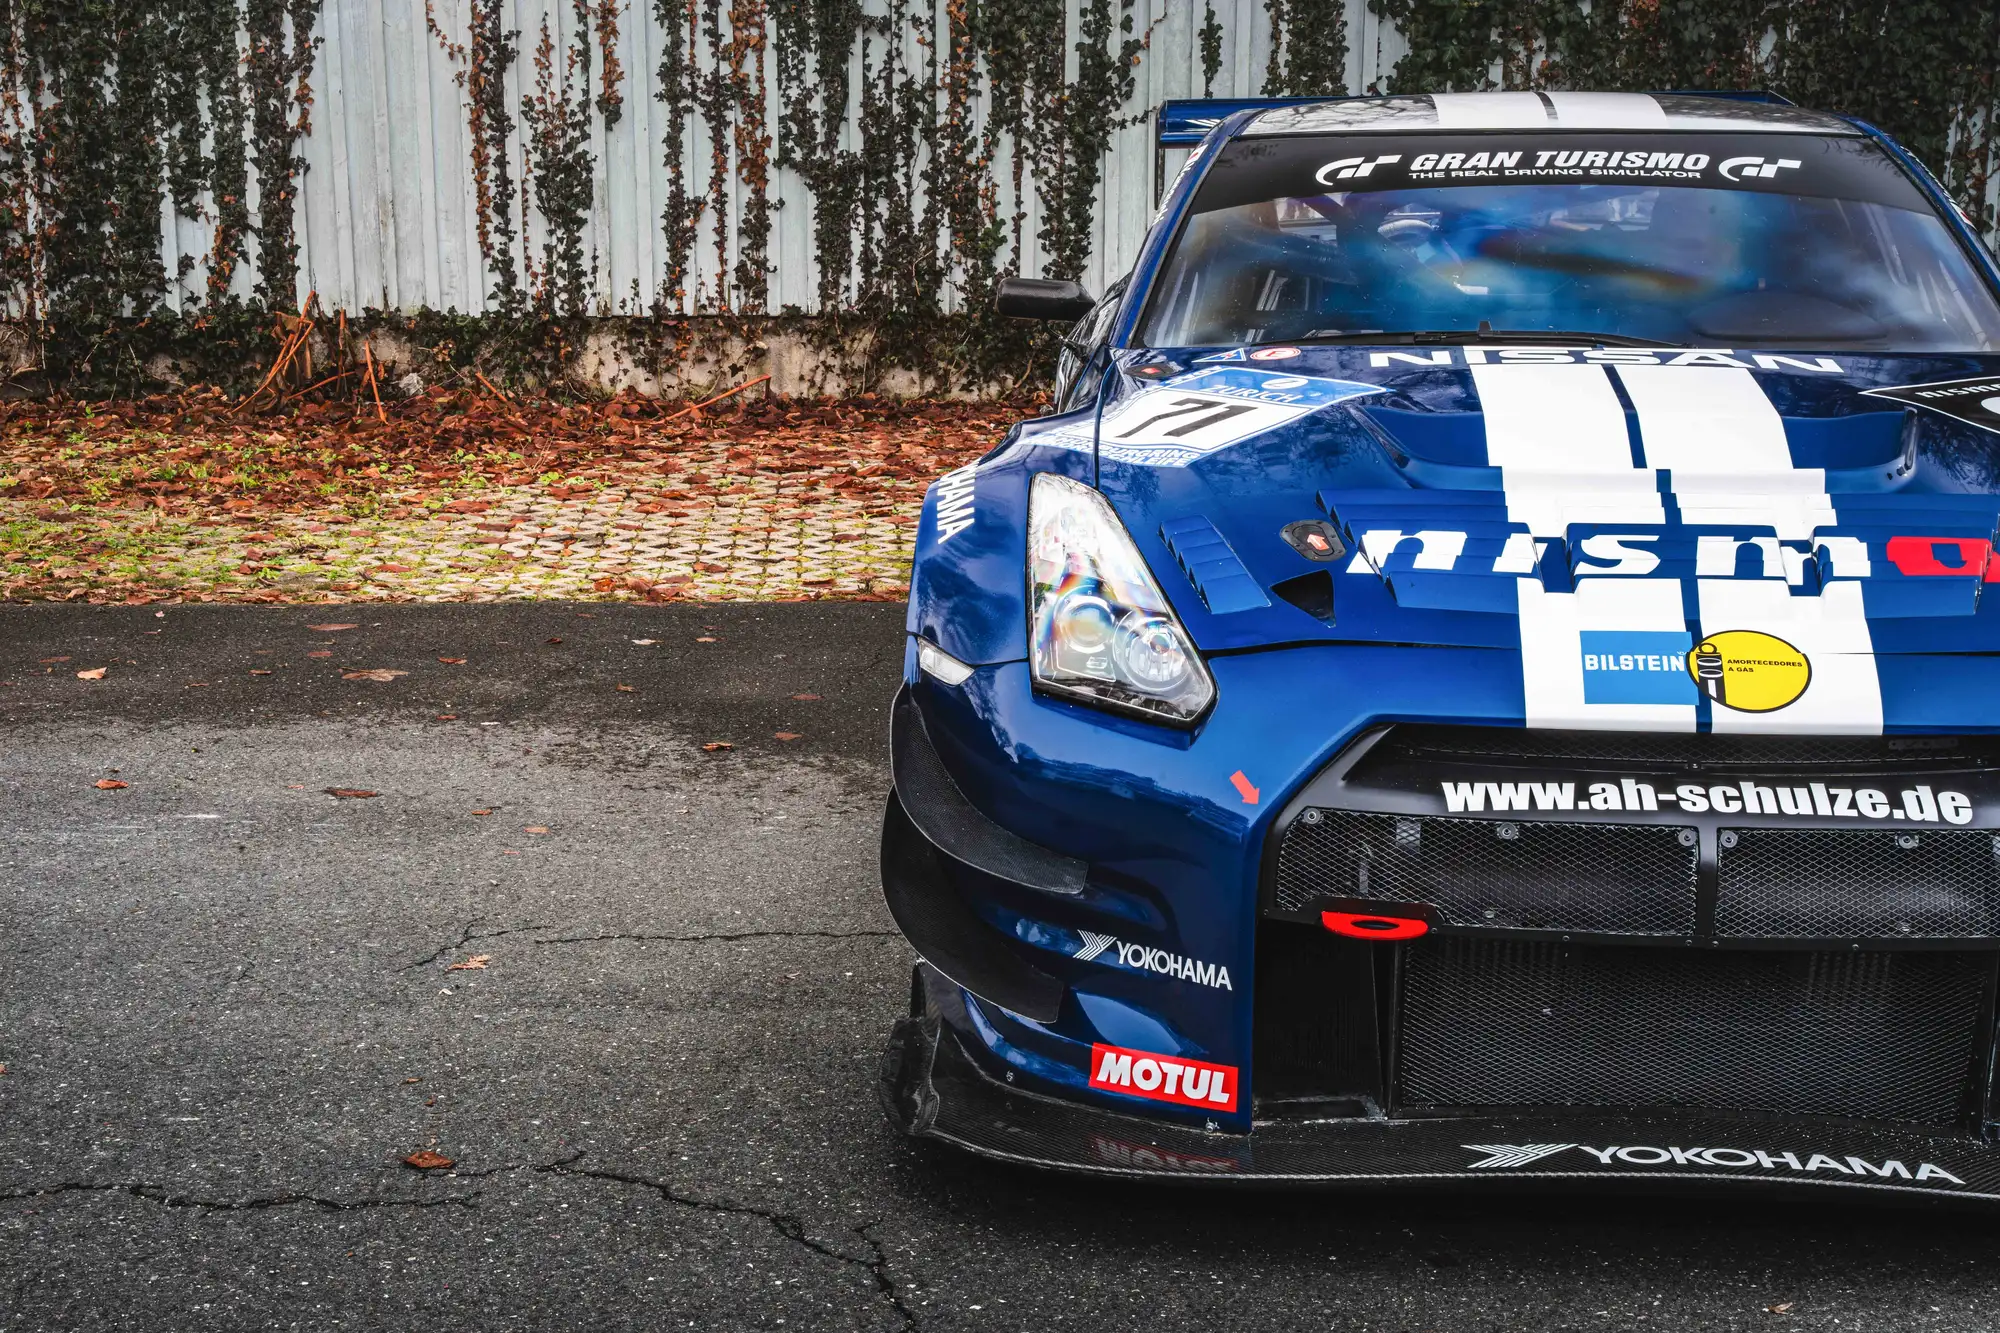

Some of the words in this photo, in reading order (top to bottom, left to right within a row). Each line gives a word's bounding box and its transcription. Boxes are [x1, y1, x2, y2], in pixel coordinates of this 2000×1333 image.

[1410, 151, 1523, 171] GRAN
[1534, 151, 1711, 171] TURISMO
[1451, 169, 1499, 177] REAL
[1505, 168, 1583, 176] DRIVING
[1589, 168, 1701, 179] SIMULATOR
[1370, 346, 1844, 373] NISSAN
[1115, 398, 1258, 438] 71
[1347, 529, 2000, 583] nismo
[1584, 654, 1686, 672] BILSTEIN
[1727, 659, 1803, 668] AMORTECEDORES
[1442, 779, 1974, 825] www.ah-schulze.de
[1116, 941, 1233, 991] YOKOHAMA
[1096, 1052, 1230, 1104] MOTUL
[1579, 1146, 1966, 1184] YOKOHAMA
